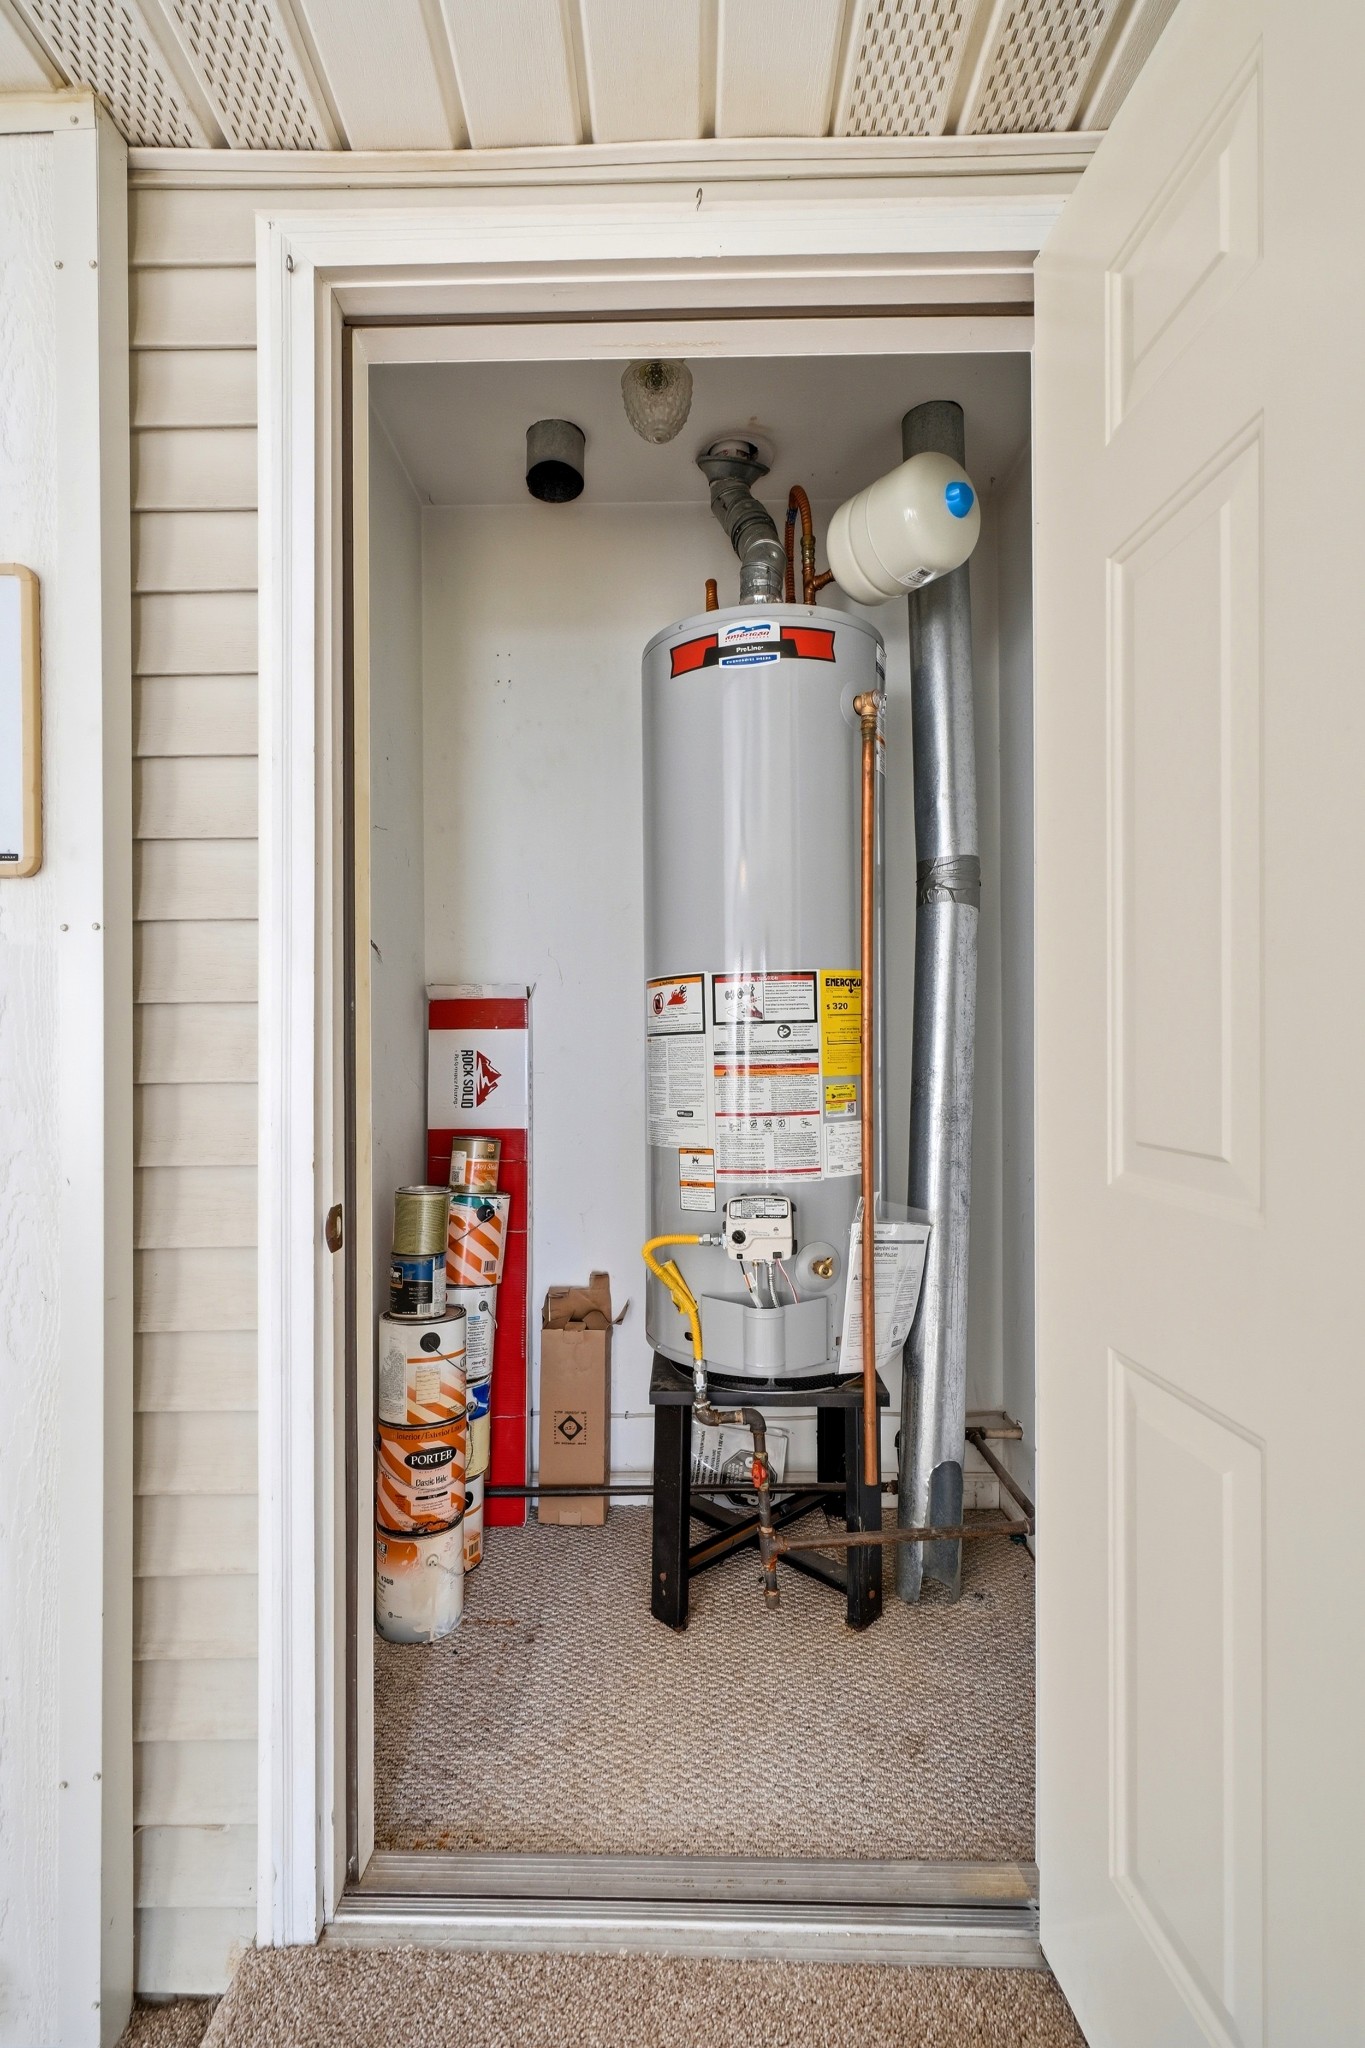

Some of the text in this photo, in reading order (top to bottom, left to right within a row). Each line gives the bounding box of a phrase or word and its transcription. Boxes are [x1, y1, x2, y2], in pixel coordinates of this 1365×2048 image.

[832, 1002, 848, 1010] 320
[461, 1049, 474, 1109] ROCK SOLID
[410, 1449, 454, 1466] PORTER
